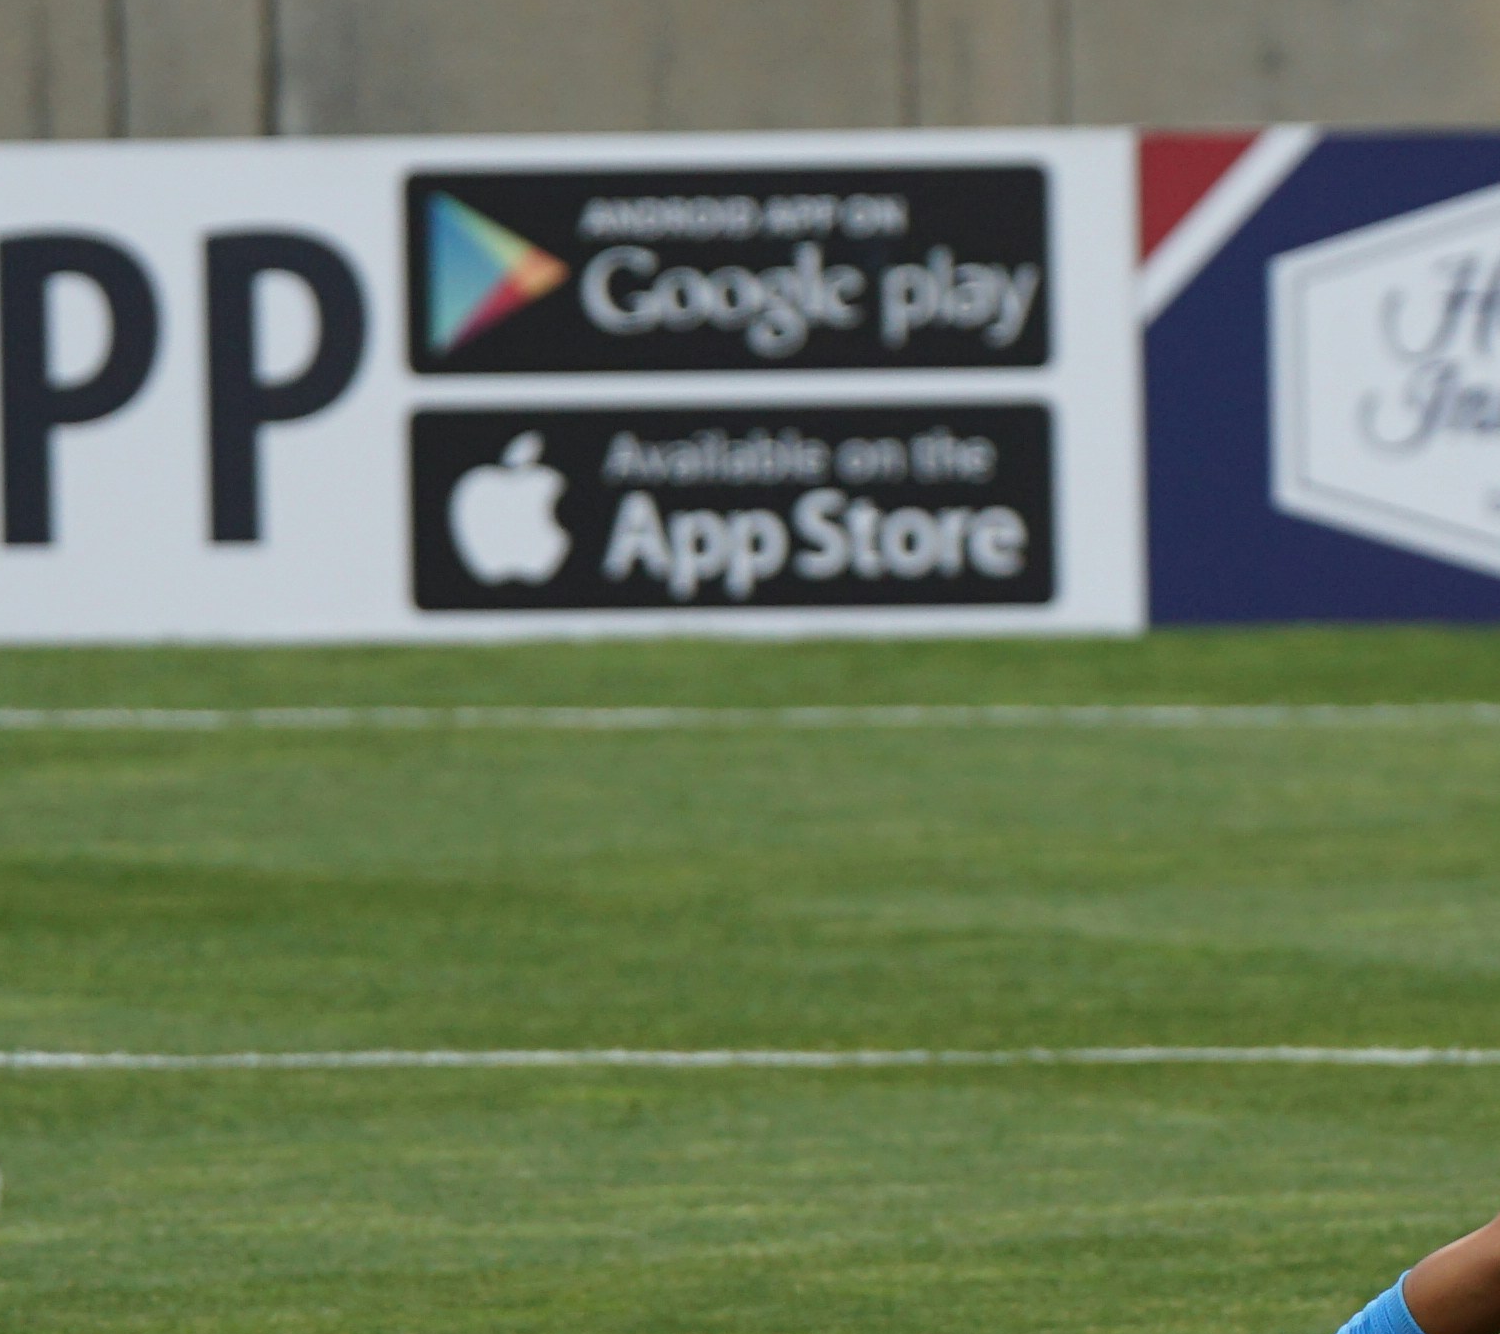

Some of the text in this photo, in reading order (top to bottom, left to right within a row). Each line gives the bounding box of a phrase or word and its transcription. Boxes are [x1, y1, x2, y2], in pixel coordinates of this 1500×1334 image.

[576, 193, 909, 242] ANDROID APP ON
[580, 242, 1041, 359] Google play
[604, 426, 997, 485] Available on the
[603, 487, 1028, 600] App Store
